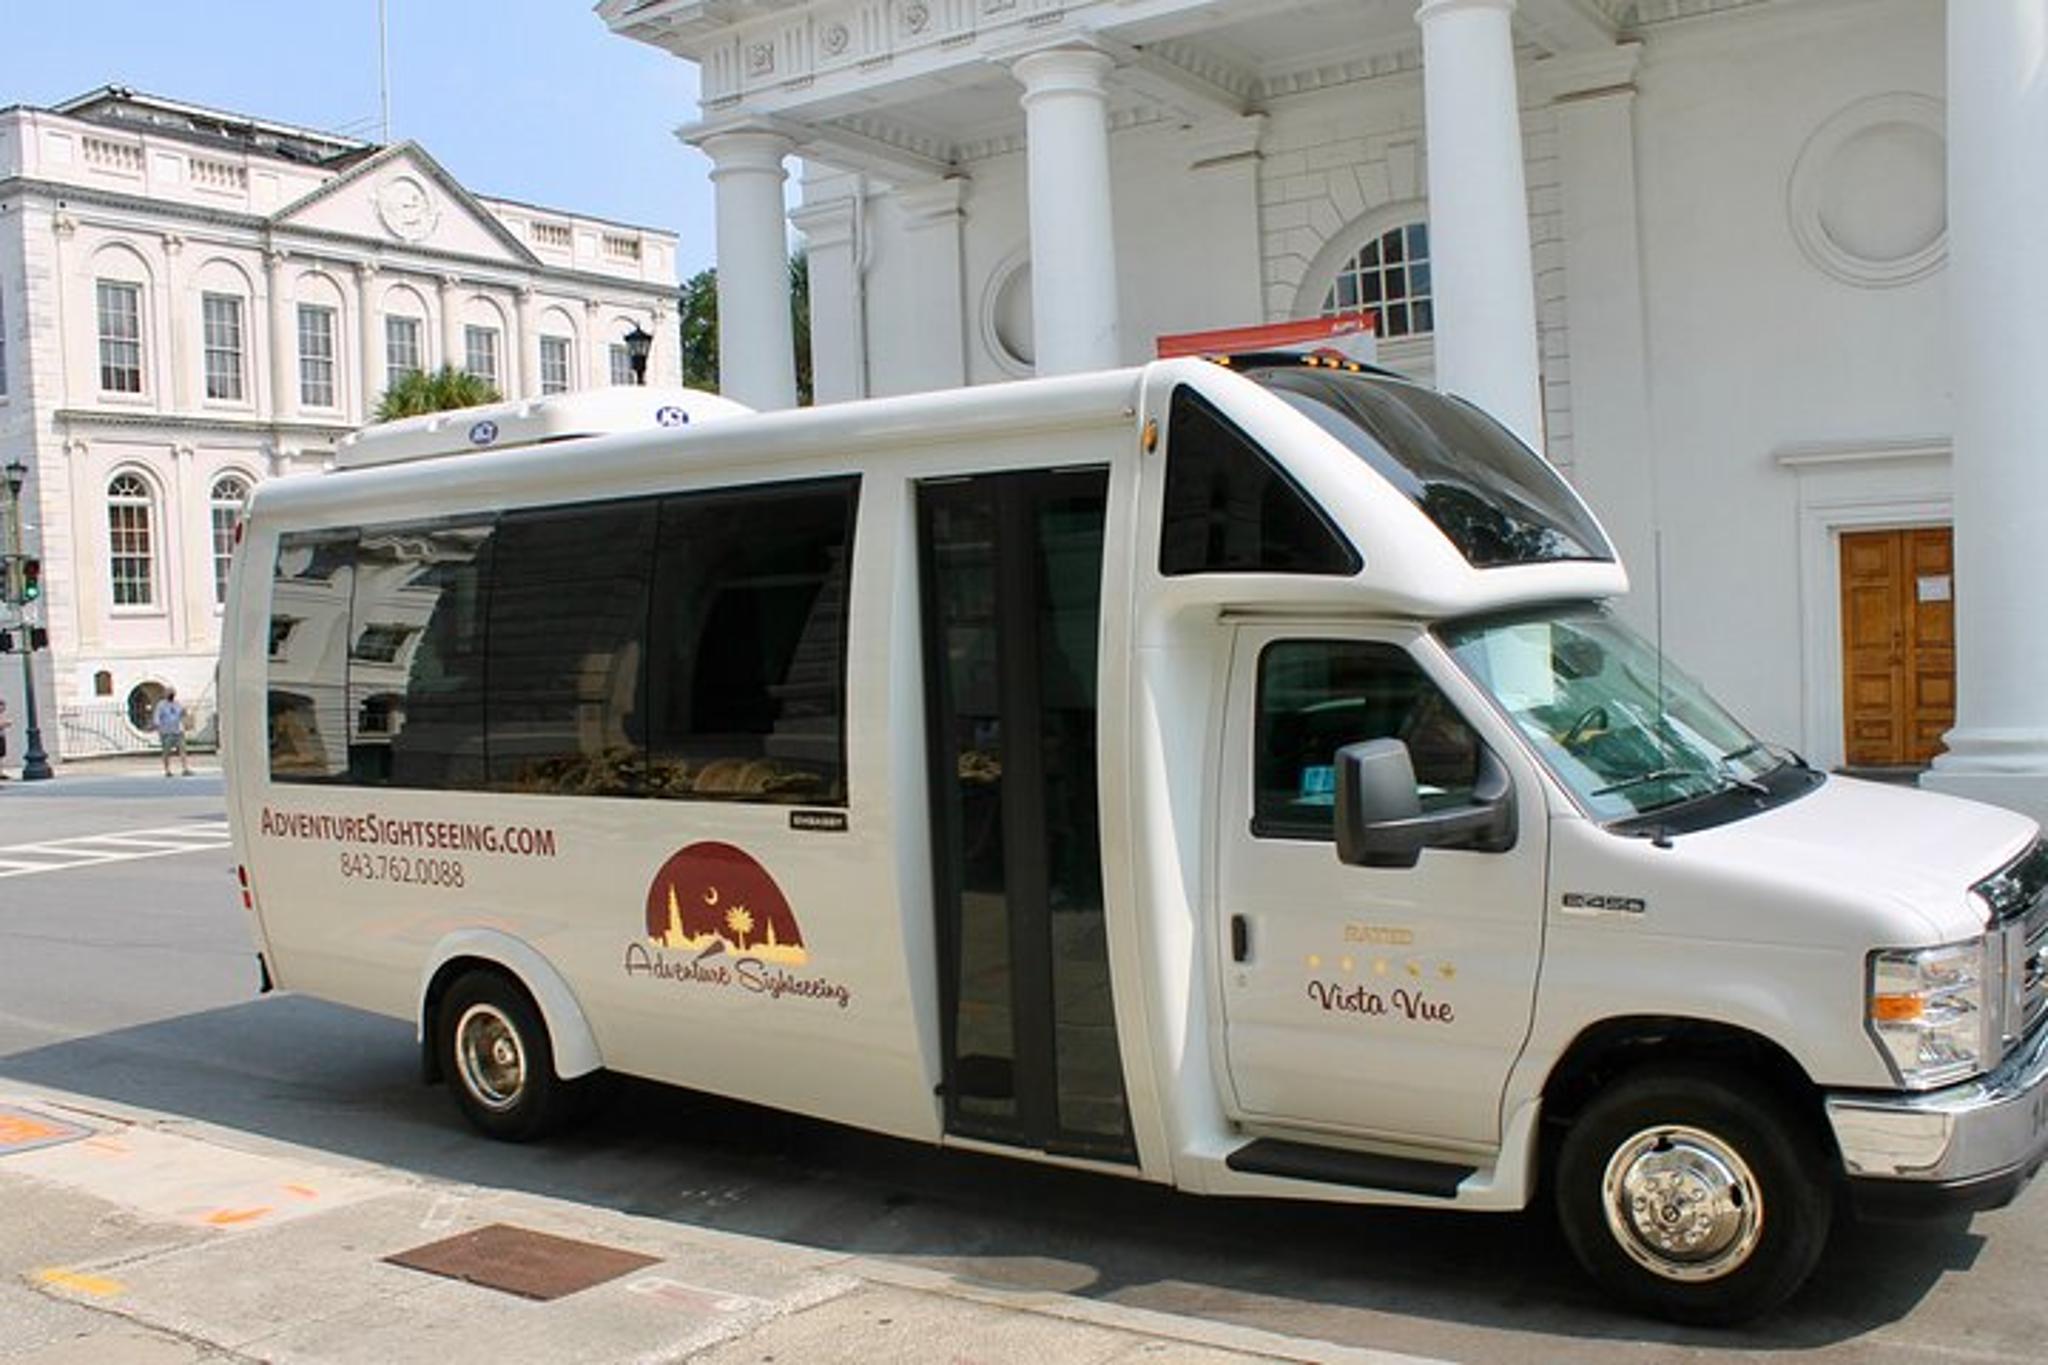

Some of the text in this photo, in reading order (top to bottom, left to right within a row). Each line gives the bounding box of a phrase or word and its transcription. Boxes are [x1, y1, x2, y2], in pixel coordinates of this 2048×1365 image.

[261, 807, 556, 856] ADVENTURESIGHTSEEING.COM
[340, 852, 465, 888] 843.762.0088
[625, 941, 850, 1007] Adventure Sightseeing
[1308, 980, 1455, 1024] Vista Vue
